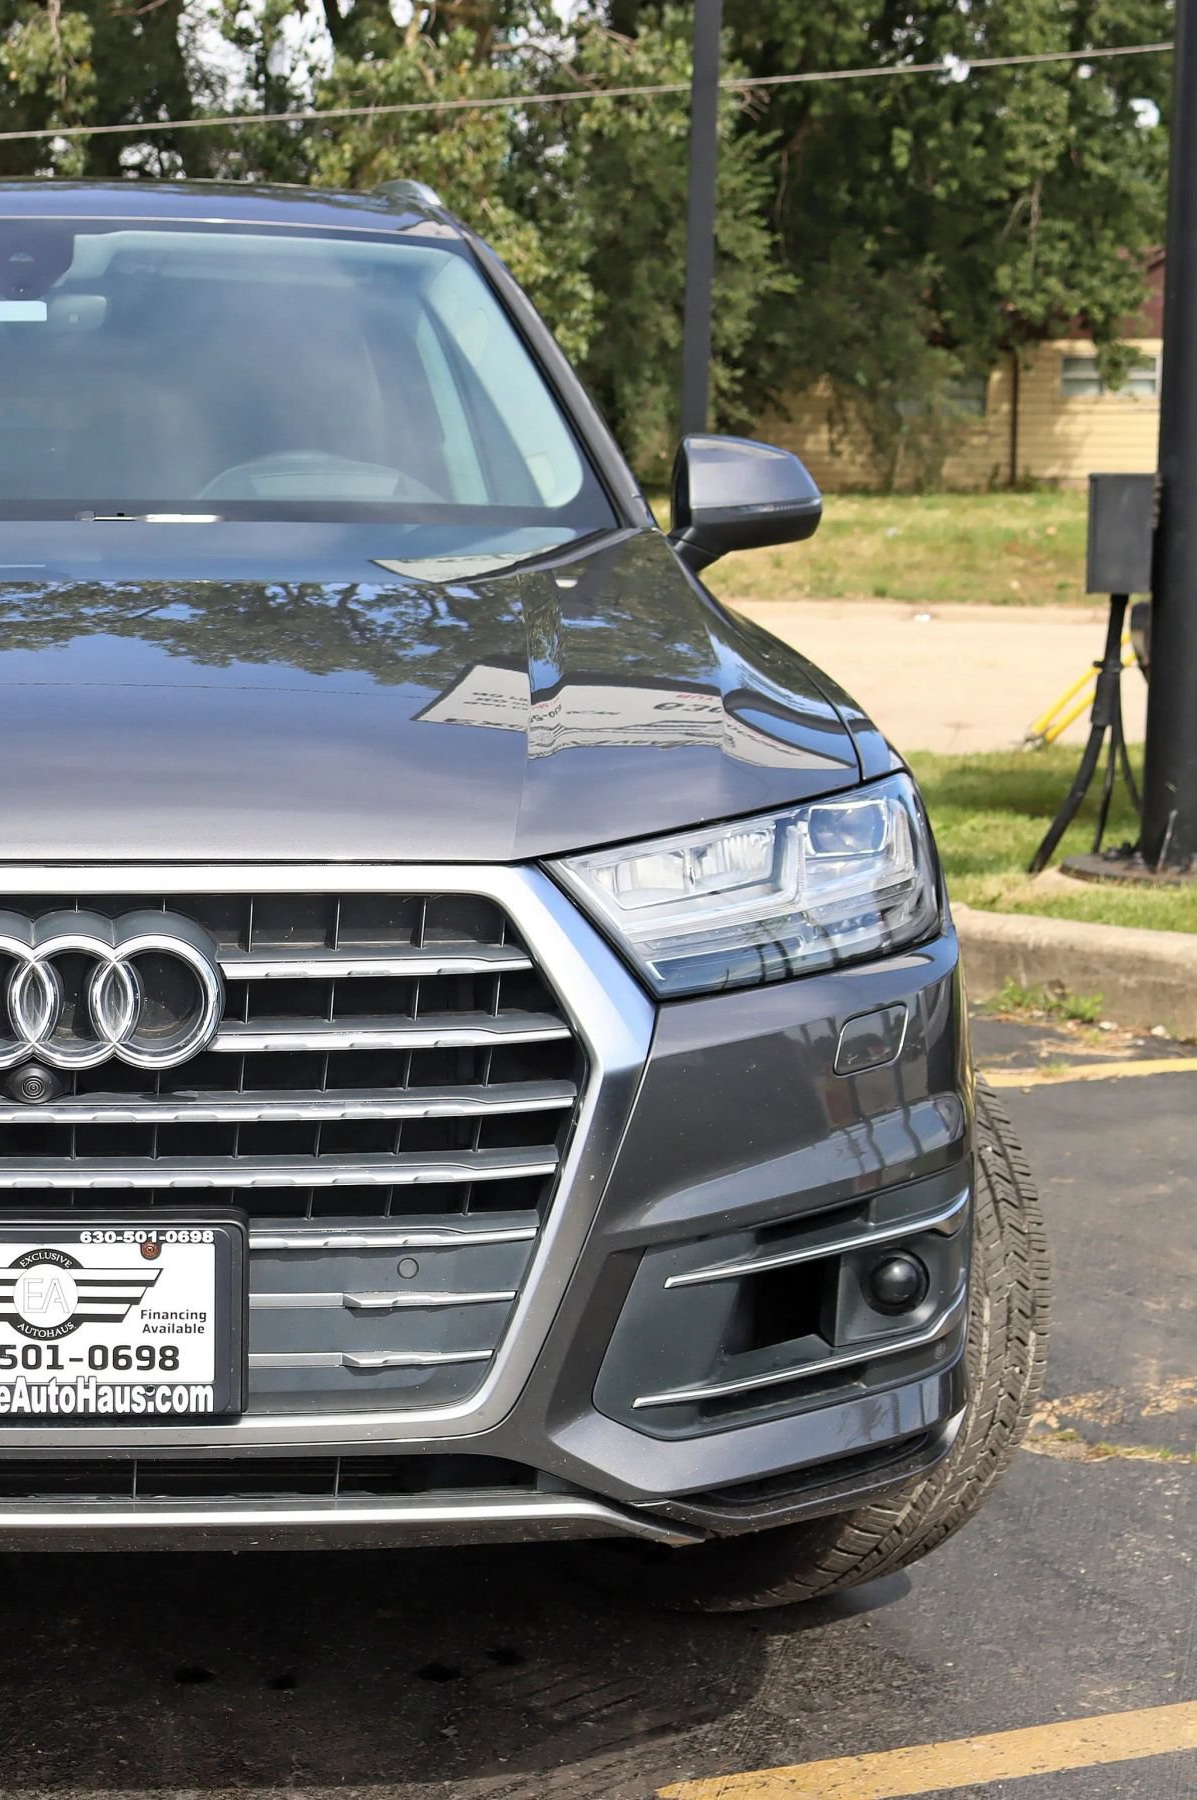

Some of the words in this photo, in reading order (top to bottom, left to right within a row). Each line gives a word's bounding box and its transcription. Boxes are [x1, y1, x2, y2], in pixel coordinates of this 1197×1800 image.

[79, 1230, 215, 1244] 630-501-0698
[19, 1251, 73, 1269] EXCLUSIVE
[23, 1277, 70, 1314] EA
[140, 1308, 207, 1322] Financing
[17, 1320, 76, 1338] AUTOHAUS
[142, 1323, 206, 1334] Available
